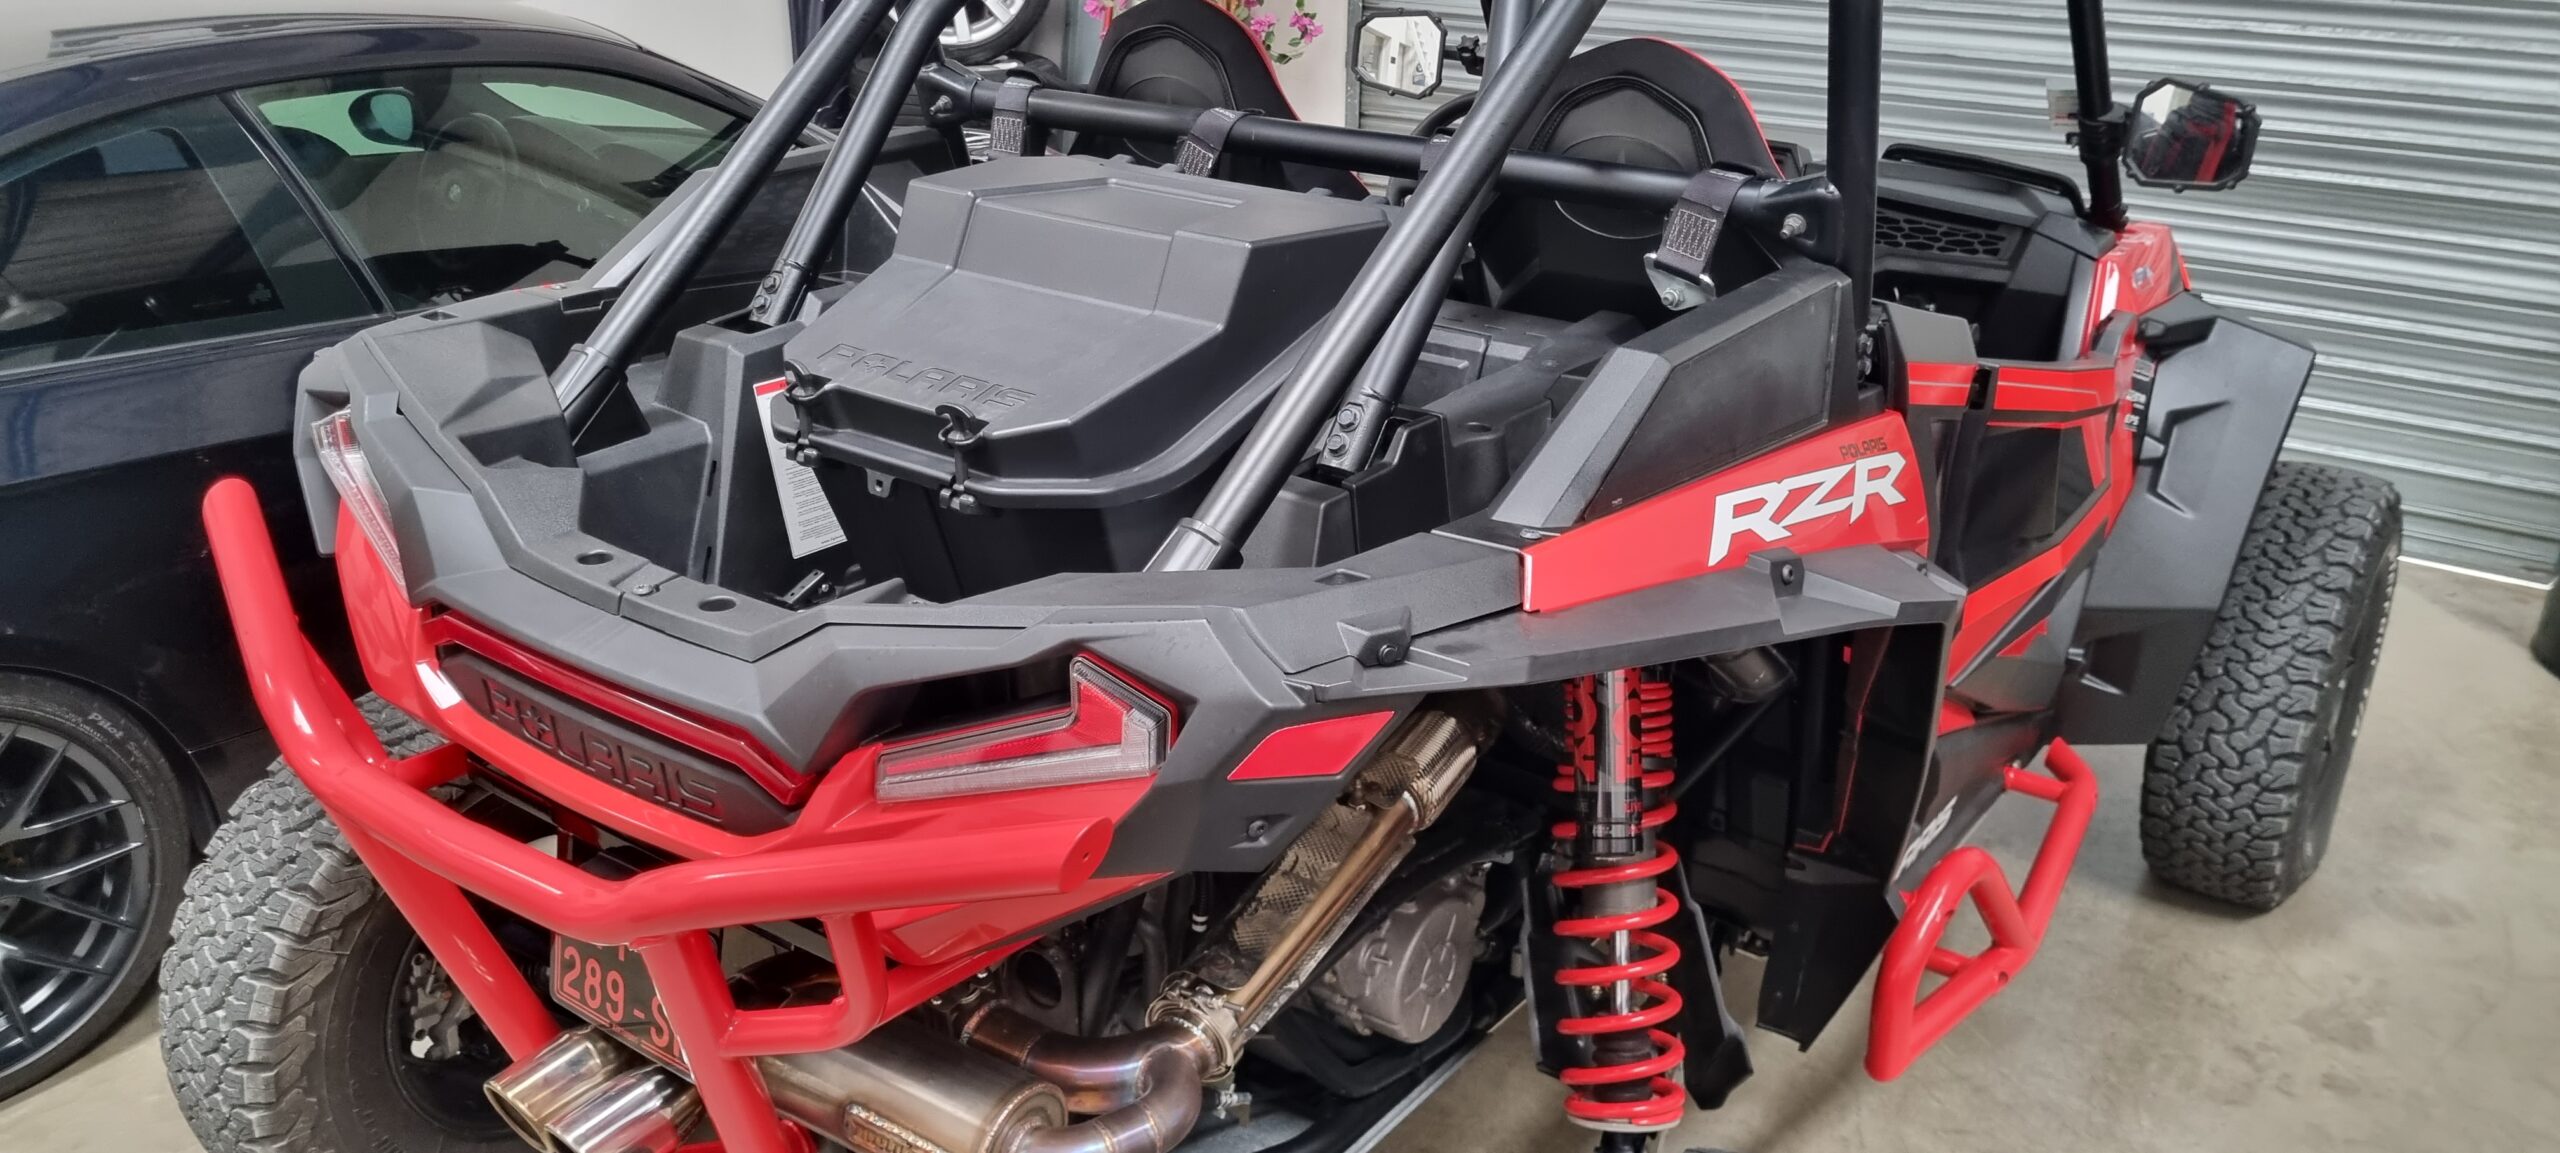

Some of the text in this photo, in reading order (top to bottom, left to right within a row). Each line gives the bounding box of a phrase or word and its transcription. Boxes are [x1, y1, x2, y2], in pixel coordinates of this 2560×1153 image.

[817, 343, 1038, 407] POLARIS
[1839, 436, 1888, 460] POLARIS
[1707, 451, 1907, 567] RZR
[88, 712, 125, 739] Pilot
[482, 678, 724, 822] POLARIS
[564, 945, 682, 1057] 289-S
